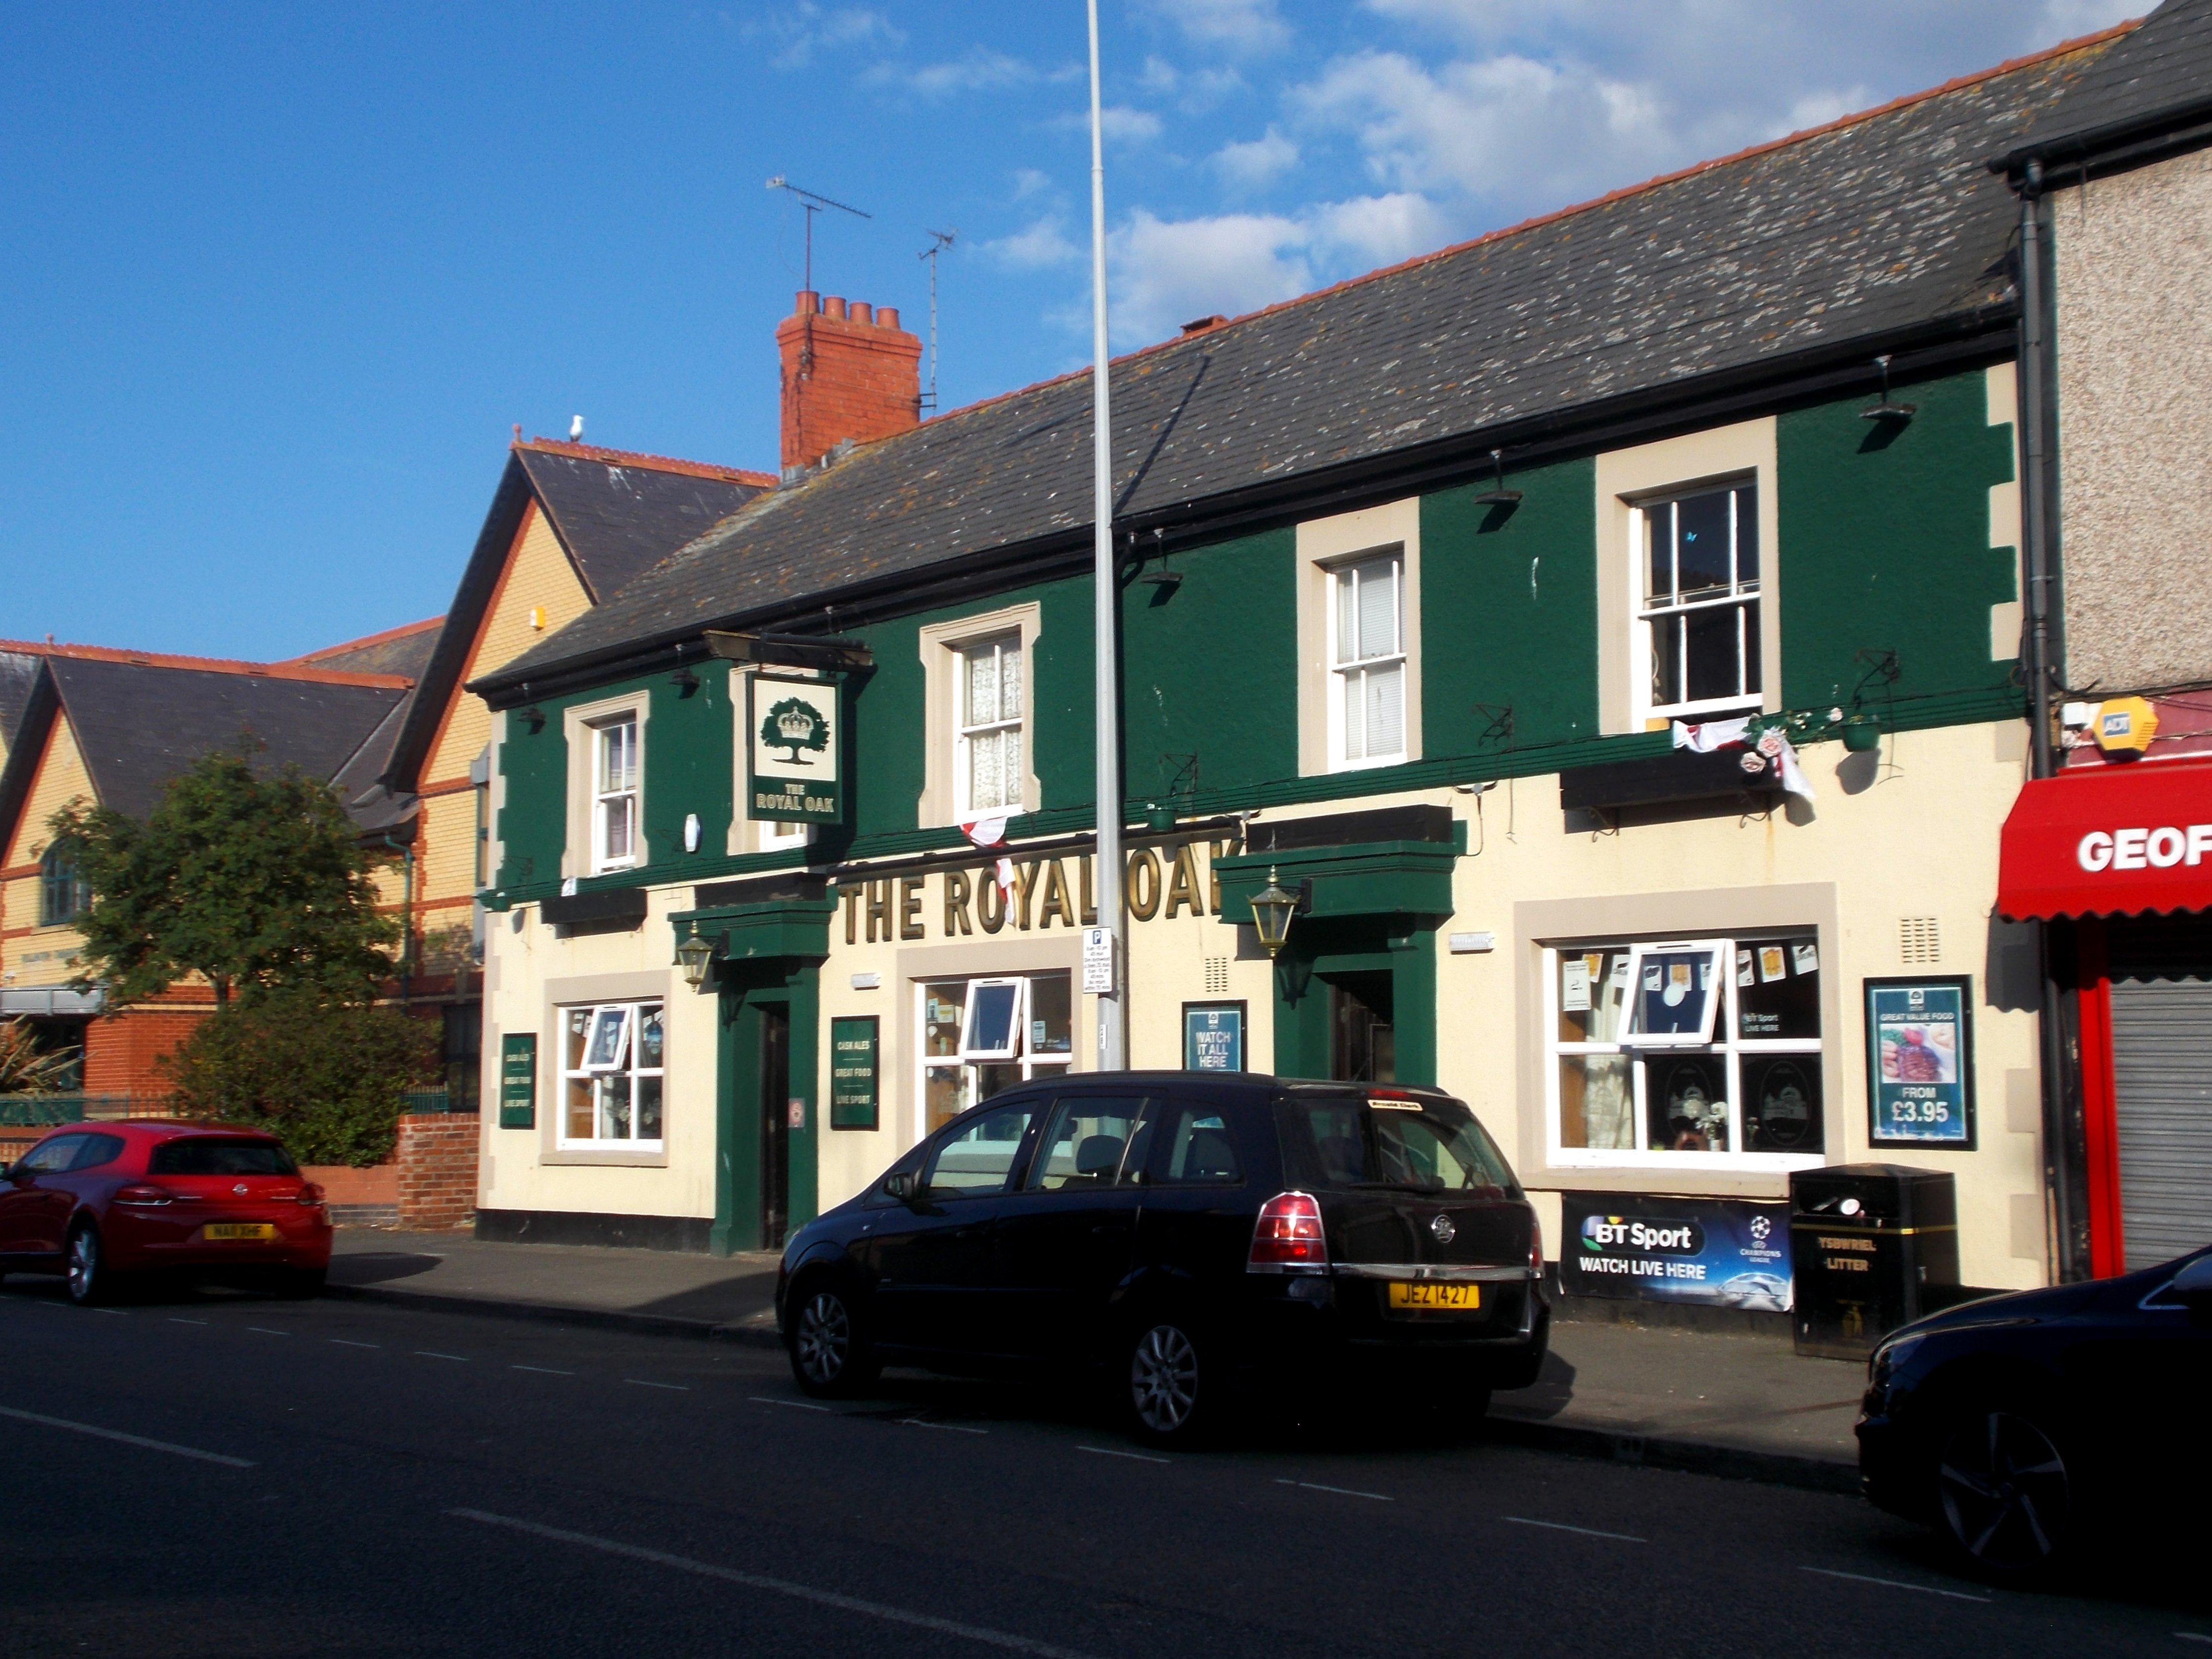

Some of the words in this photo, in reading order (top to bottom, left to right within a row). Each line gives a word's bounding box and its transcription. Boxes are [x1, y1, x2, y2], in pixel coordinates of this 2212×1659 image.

[2104, 717, 2129, 732] ADT
[785, 784, 805, 795] THE
[756, 793, 802, 810] ROYAL
[805, 797, 834, 812] OAK
[838, 873, 925, 945] THE
[944, 856, 1097, 934] ROYAL
[1195, 1031, 1231, 1044] WATCH
[1197, 1044, 1207, 1055] IT
[1208, 1044, 1229, 1055] ALL
[1199, 1055, 1227, 1067] HERE
[854, 1068, 872, 1077] FOOD
[850, 1094, 870, 1104] SPORT
[1903, 1088, 1937, 1098] FROM
[1892, 1101, 1948, 1122] £3.95
[1596, 1224, 1629, 1244] BT
[1631, 1223, 1691, 1250] Sport
[1580, 1257, 1629, 1273] WATCH
[1632, 1260, 1664, 1276] LIVE
[1666, 1263, 1706, 1279] HERE
[1827, 1258, 1868, 1271] LITTER
